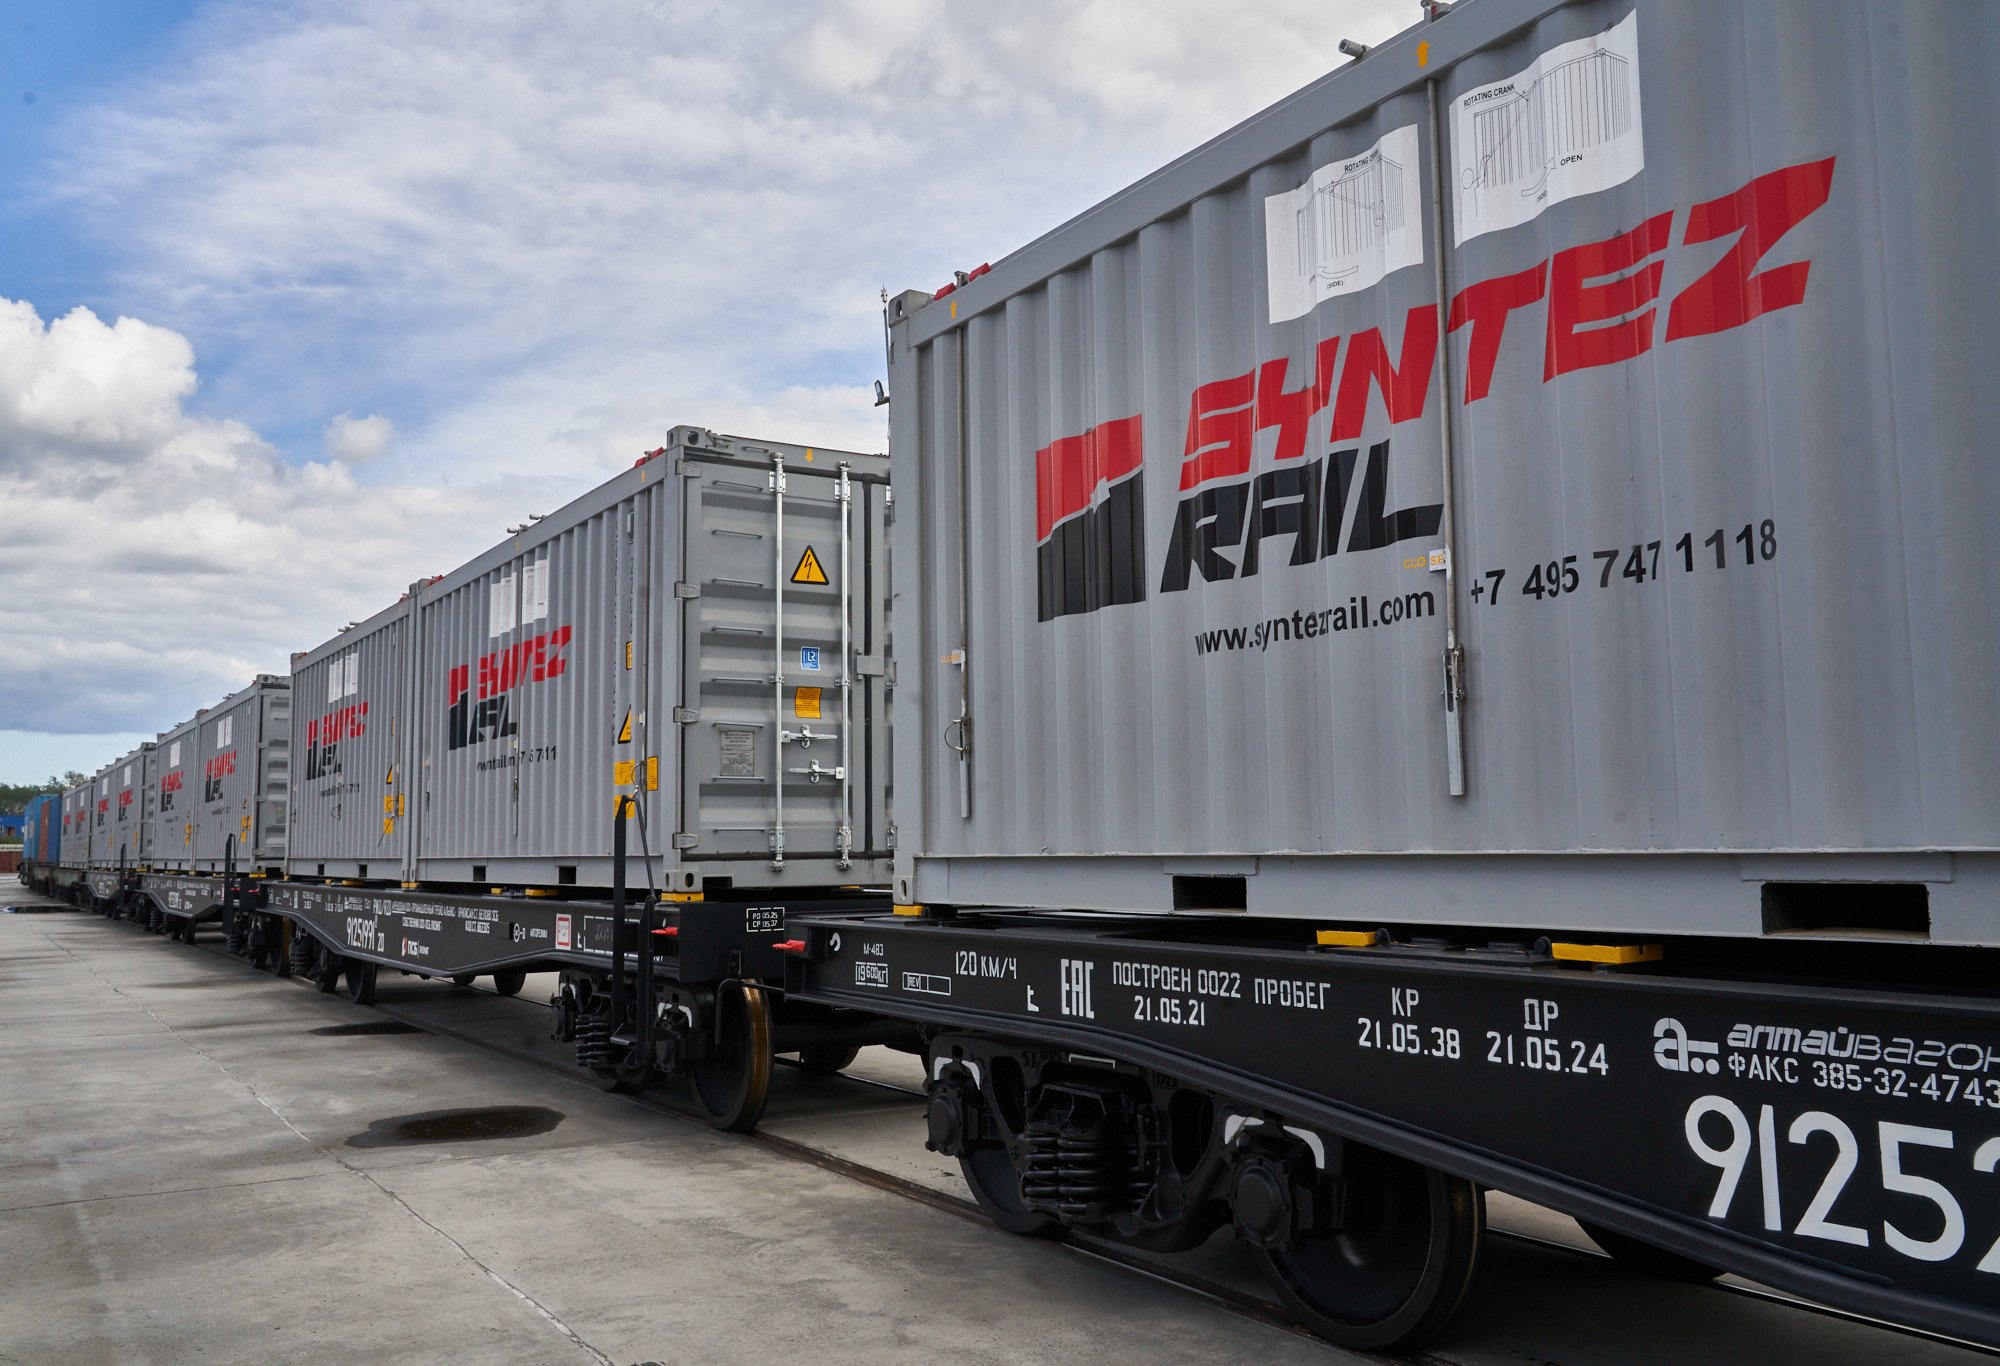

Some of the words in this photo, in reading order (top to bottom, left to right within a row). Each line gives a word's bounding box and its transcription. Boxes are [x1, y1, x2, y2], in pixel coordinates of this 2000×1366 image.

[1464, 91, 1493, 107] ROTATING
[1494, 83, 1516, 97] CRANK
[1344, 156, 1369, 172] ROTATING
[1560, 154, 1583, 166] OPEN
[1180, 158, 1834, 491] SYNTEZ
[1160, 438, 1444, 593] RAIL
[1403, 553, 1445, 569] CLOSE
[1470, 569, 1505, 606] +7
[1522, 555, 1580, 601] 495
[1592, 539, 1661, 589] 747
[1675, 518, 1777, 573] 1118
[1195, 588, 1434, 654] www.syntezrail.com
[807, 651, 816, 662] LR
[955, 951, 978, 976] 120
[980, 956, 1018, 980] КМ/Ч
[1112, 961, 1192, 994] ПОСТРОЕН
[1197, 969, 1242, 999] 0022
[908, 975, 920, 989] REV
[1254, 977, 1332, 1010] ПРОБЕГ
[1134, 995, 1206, 1027] 21.05.21
[1391, 987, 1419, 1017] КР
[1523, 998, 1559, 1031] ДР
[1357, 1017, 1461, 1060] 21.05.38
[1486, 1031, 1609, 1076] 21.05.24
[1727, 1052, 1799, 1084] ФАКС
